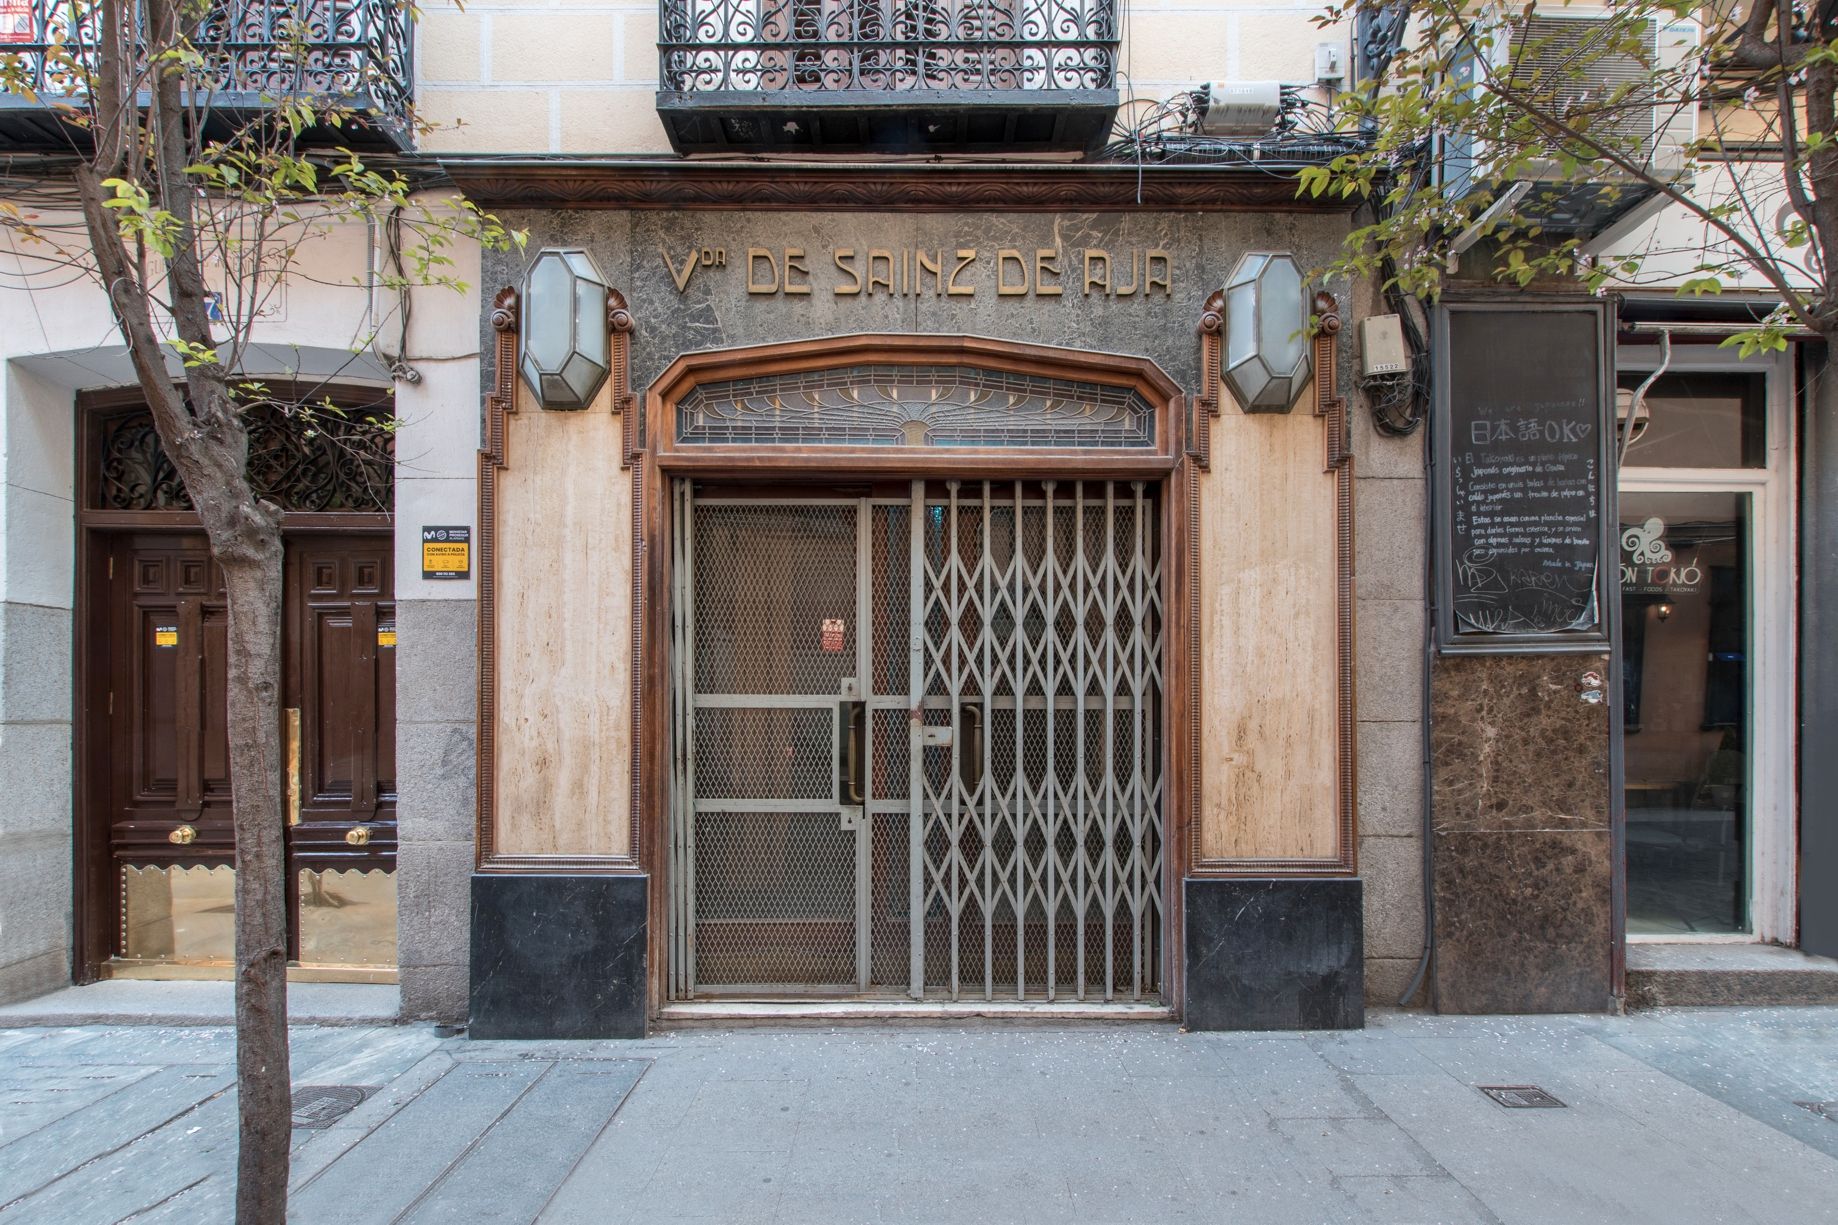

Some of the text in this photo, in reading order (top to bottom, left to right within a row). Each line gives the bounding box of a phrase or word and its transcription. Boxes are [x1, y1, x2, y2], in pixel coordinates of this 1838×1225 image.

[747, 248, 811, 295] DE
[834, 248, 977, 295] SAINZ
[998, 248, 1063, 295] DE
[1085, 248, 1173, 295] AJA
